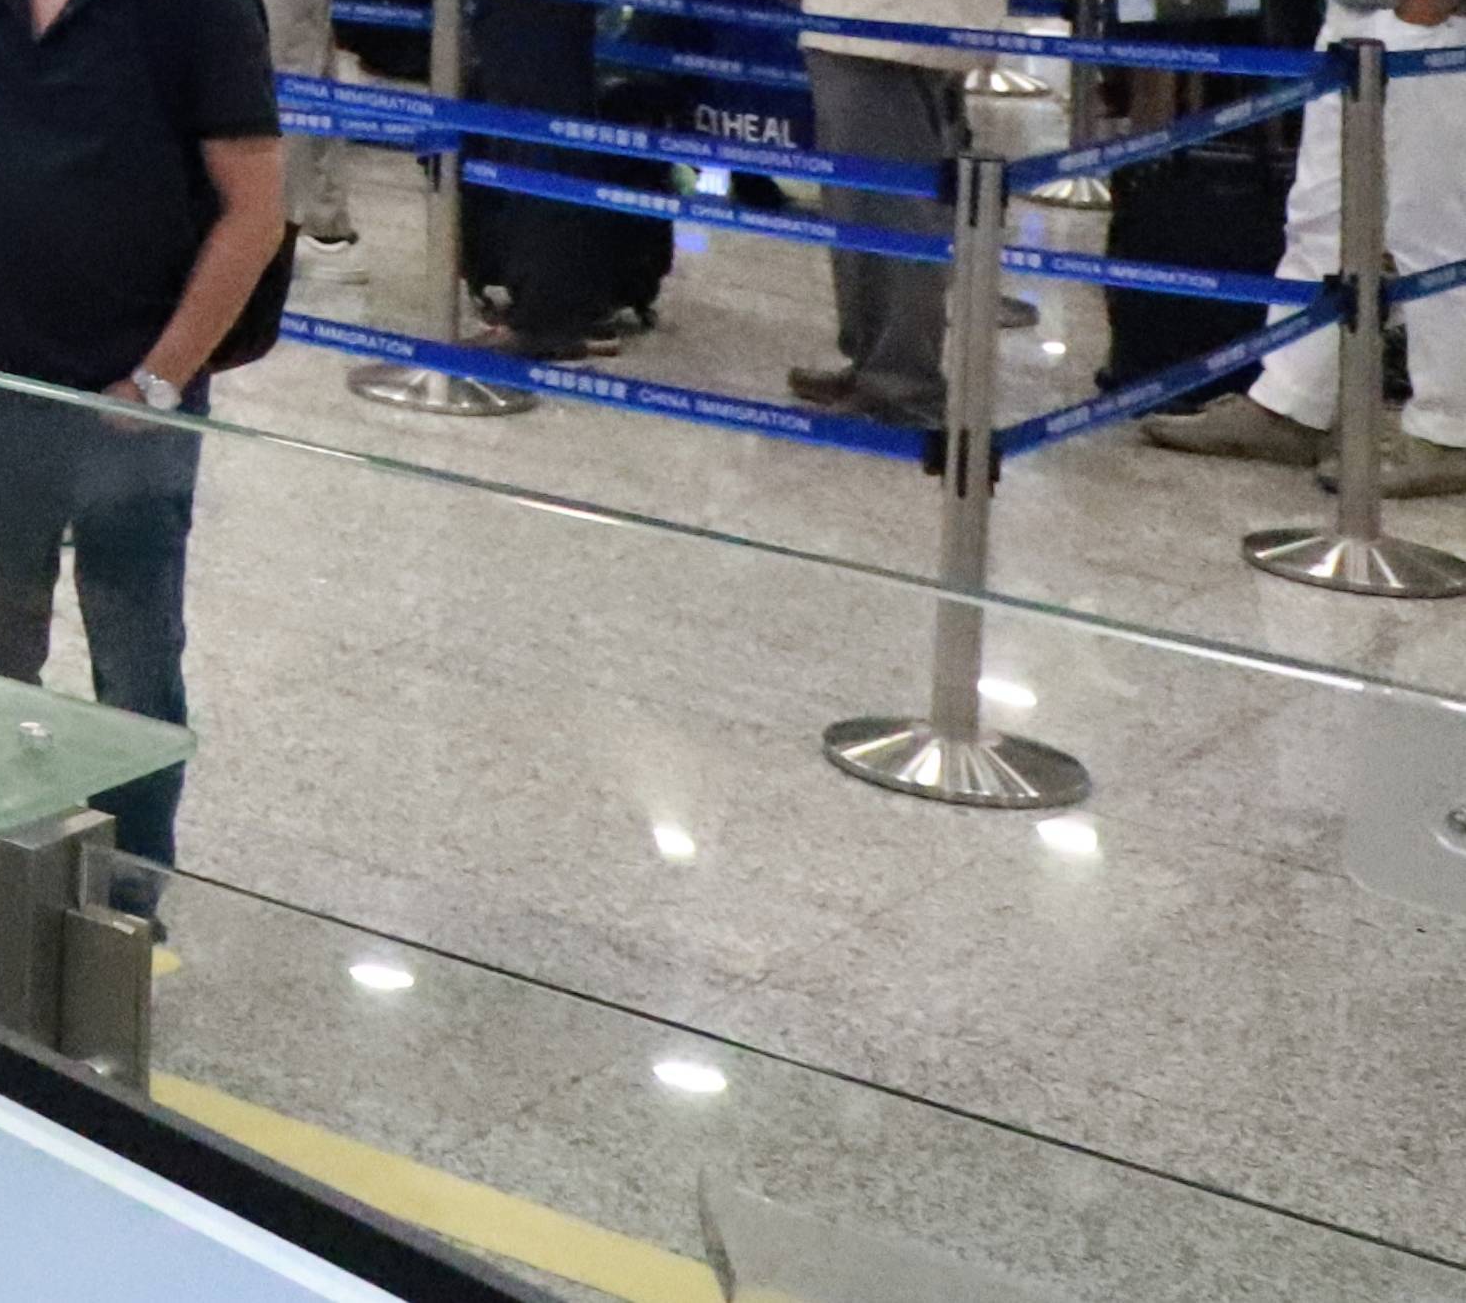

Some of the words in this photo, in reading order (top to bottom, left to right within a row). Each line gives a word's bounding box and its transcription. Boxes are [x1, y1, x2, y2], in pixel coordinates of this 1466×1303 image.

[283, 79, 329, 98] CHINA
[333, 86, 436, 116] IMMIGRATION
[313, 324, 415, 359] IMMIGRATION
[637, 385, 691, 410] CHINA
[699, 394, 814, 434] IMMIGRATION
